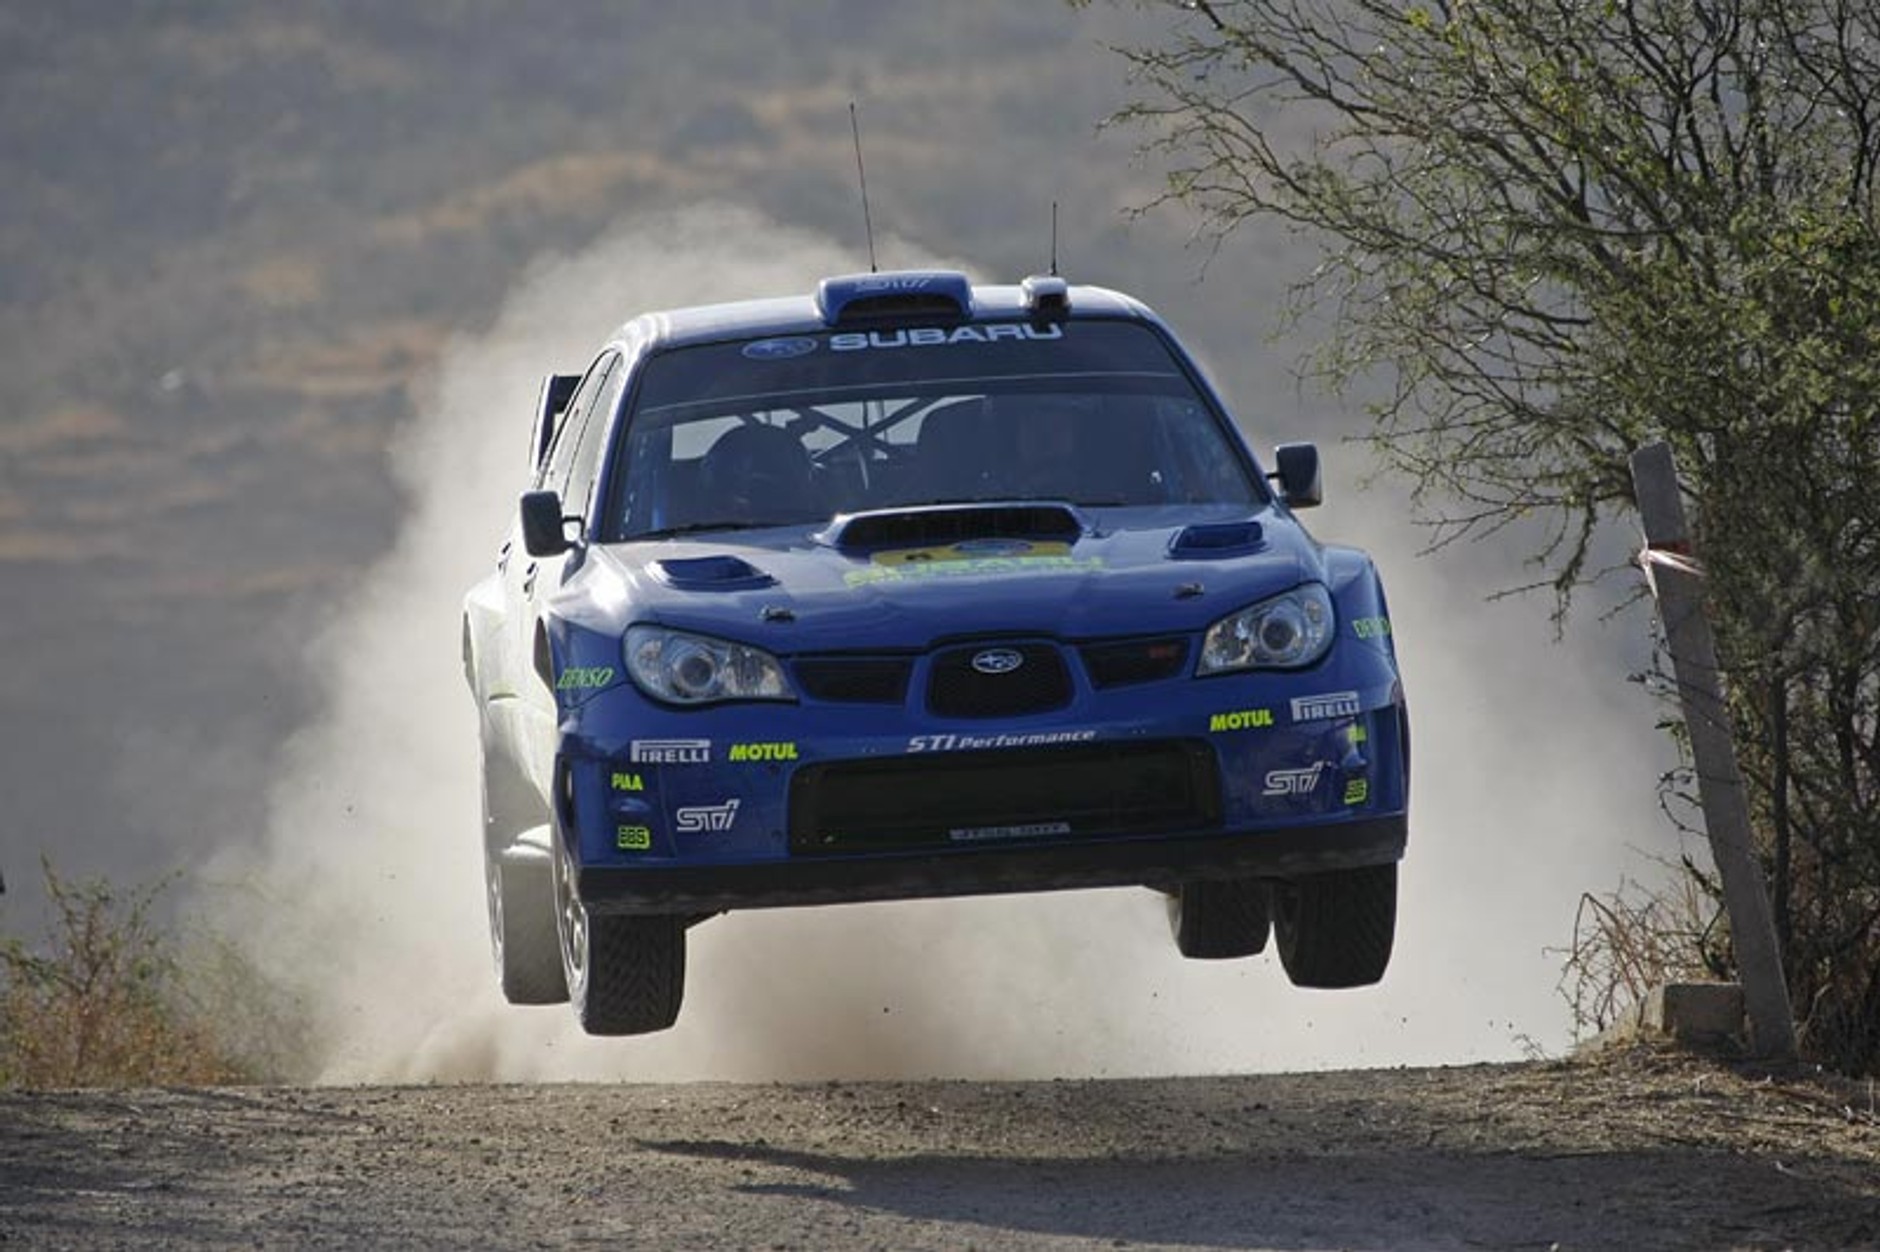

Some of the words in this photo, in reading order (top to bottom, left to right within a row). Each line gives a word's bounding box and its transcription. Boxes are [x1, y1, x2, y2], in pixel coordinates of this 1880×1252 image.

[830, 324, 1062, 350] SUBARU
[1289, 690, 1361, 722] PIRELLI
[1210, 709, 1273, 732] MOTUL
[630, 739, 712, 763] PIRELLI
[728, 742, 799, 762] MOTUL
[906, 733, 957, 753] STI
[957, 729, 1097, 750] Performance
